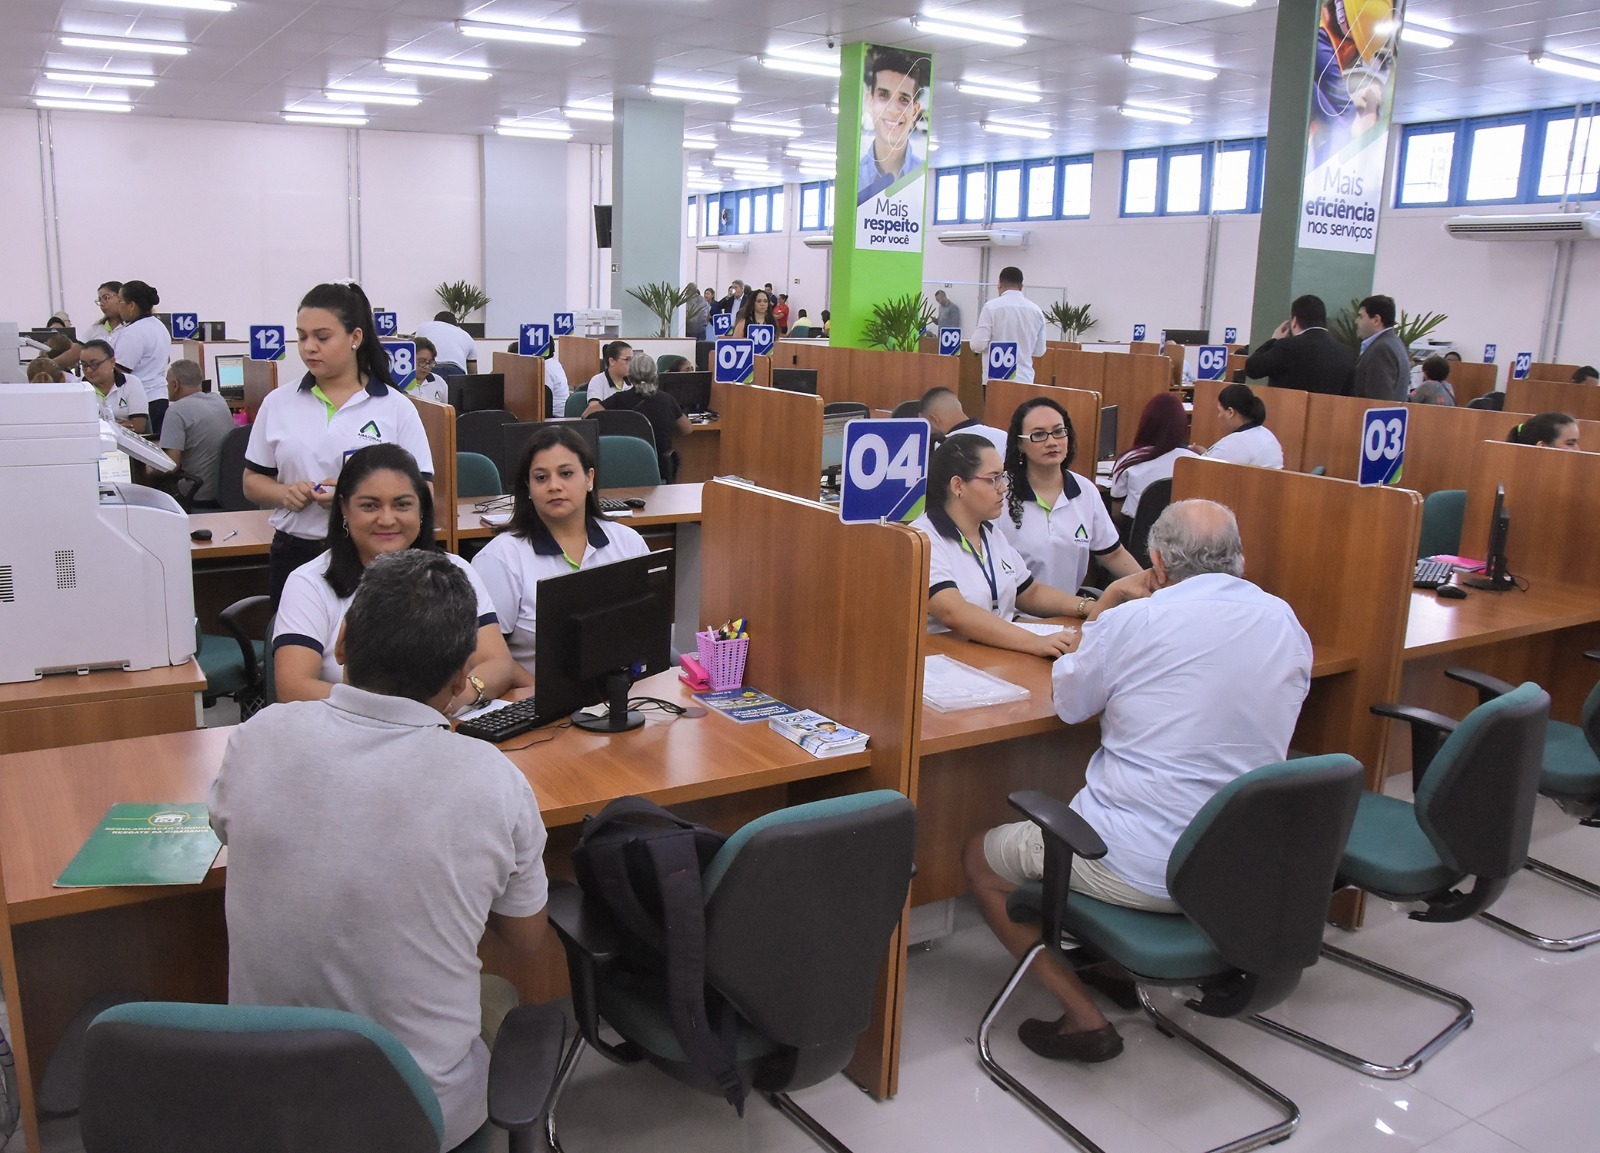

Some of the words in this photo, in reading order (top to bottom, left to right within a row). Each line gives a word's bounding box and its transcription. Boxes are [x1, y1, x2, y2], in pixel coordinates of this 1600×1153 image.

[1323, 166, 1364, 196] Mais
[875, 198, 908, 217] Mais
[1305, 196, 1375, 222] eficiência
[864, 218, 919, 234] respeito
[1307, 221, 1328, 235] nos
[1330, 222, 1373, 242] serviços
[870, 235, 886, 245] por
[888, 235, 909, 245] você
[176, 316, 195, 331] 16
[377, 315, 394, 329] 15
[556, 315, 571, 329] 14
[716, 316, 729, 329] 13
[1134, 325, 1145, 336] 29
[255, 329, 280, 349] 12
[526, 327, 543, 346] 11
[751, 328, 771, 346] 10
[942, 331, 960, 347] 09
[1225, 329, 1236, 339] 30
[718, 345, 751, 370] 07
[990, 346, 1015, 368] 06
[1200, 350, 1224, 369] 05
[1516, 355, 1530, 371] 20
[1365, 418, 1402, 461] 03
[849, 433, 922, 490] 04
